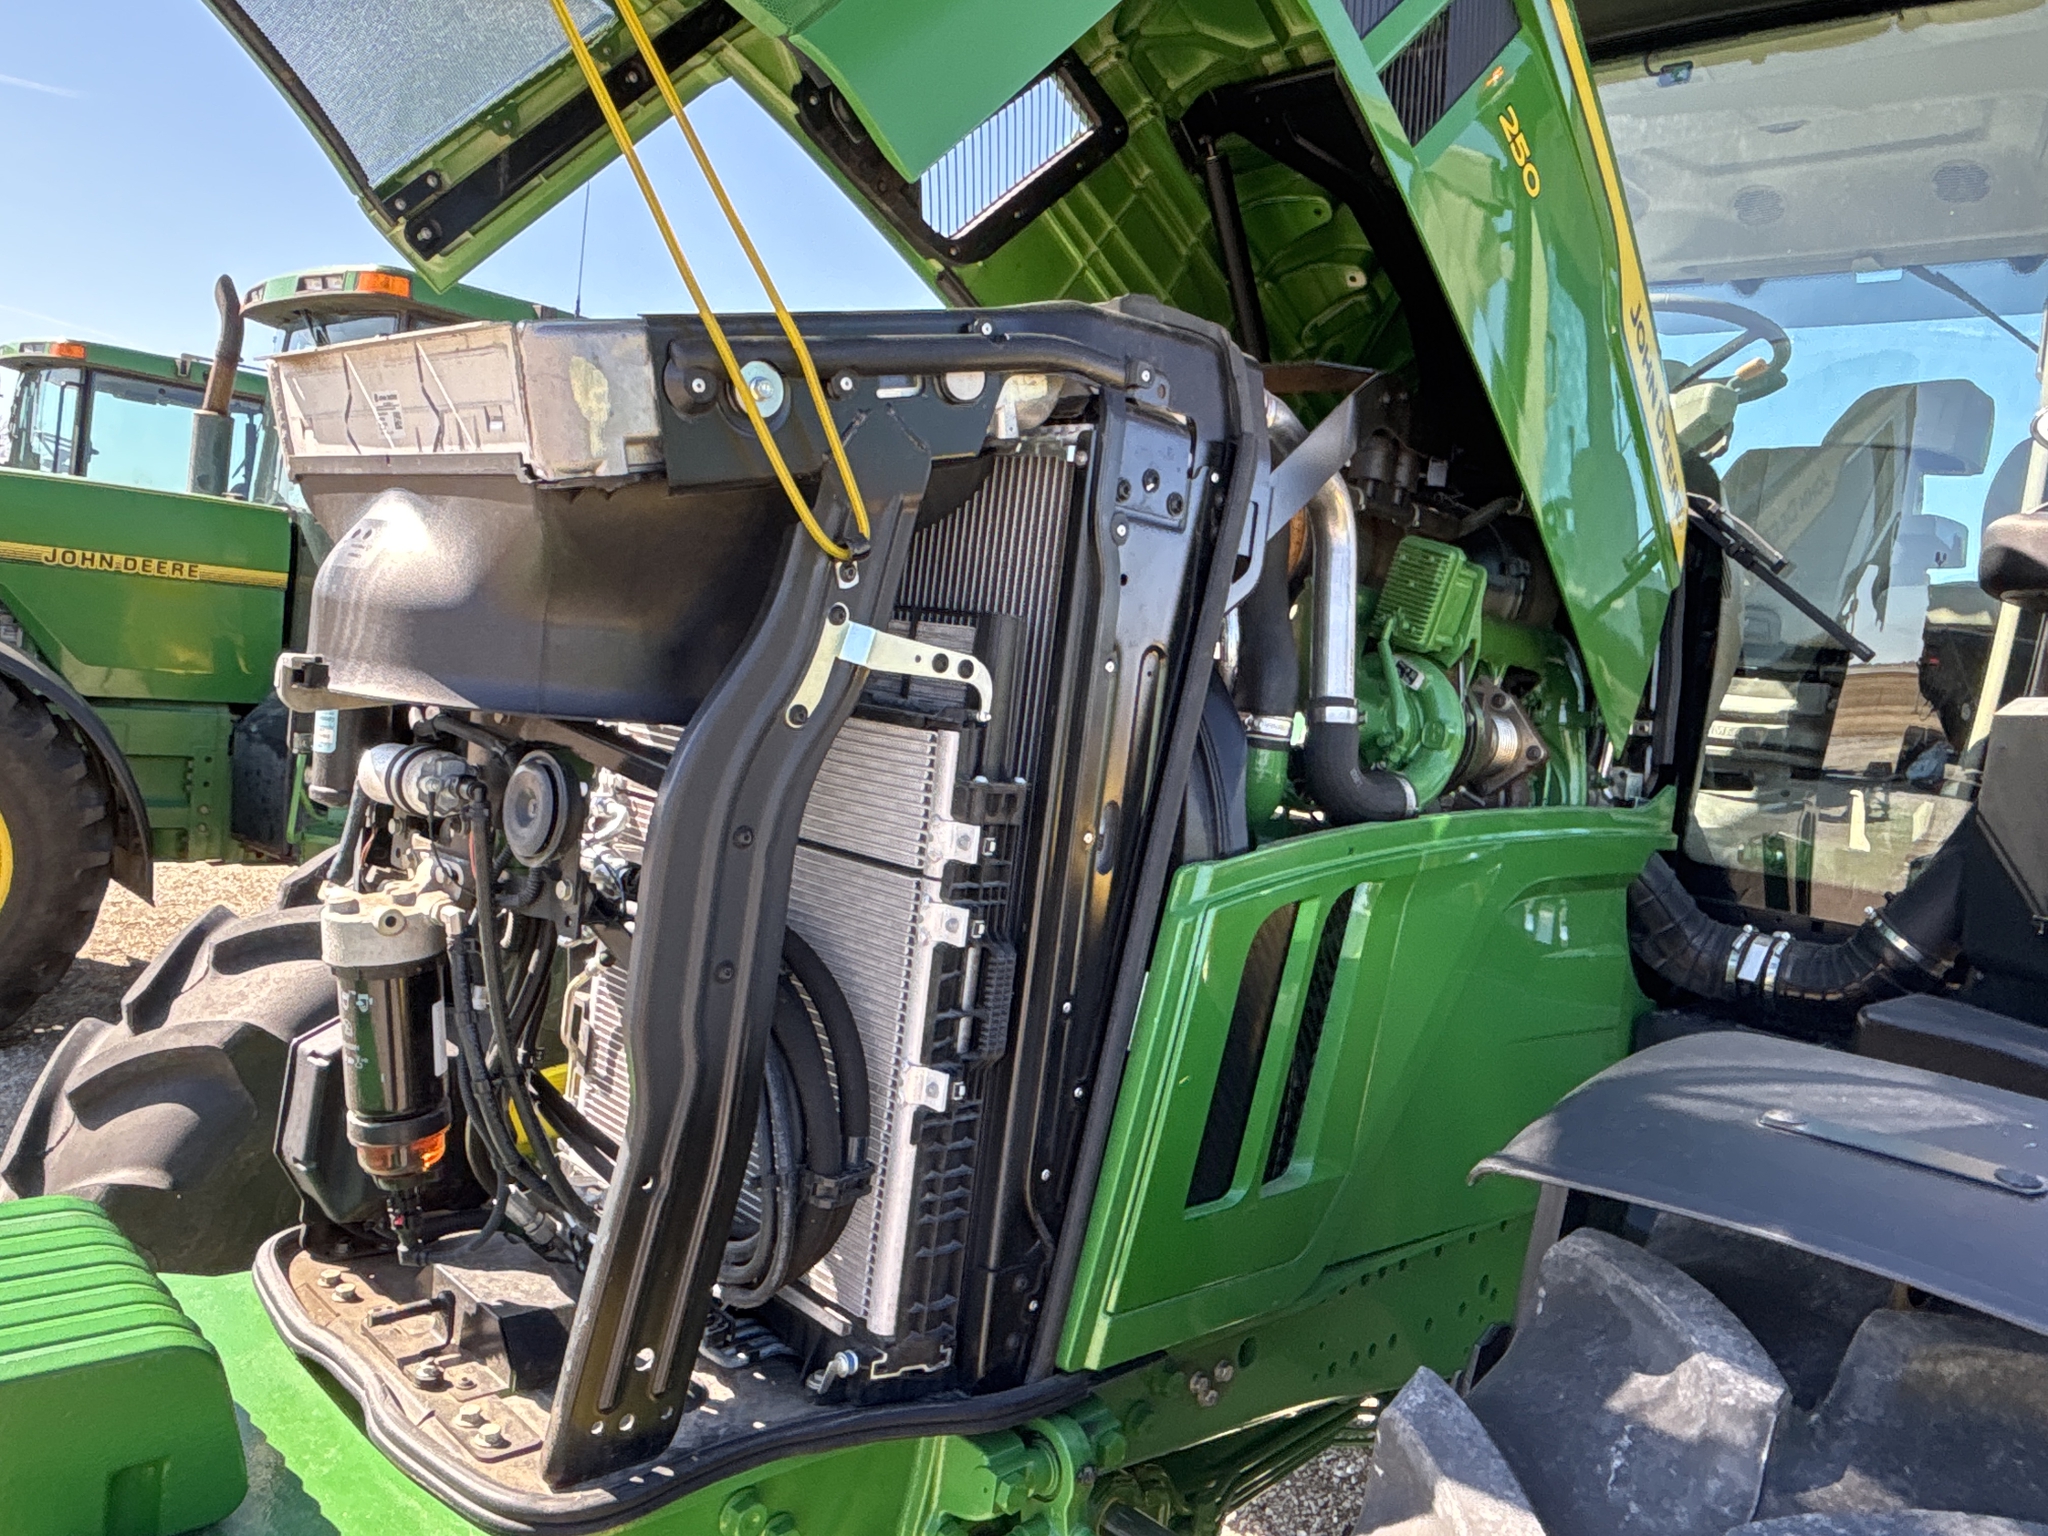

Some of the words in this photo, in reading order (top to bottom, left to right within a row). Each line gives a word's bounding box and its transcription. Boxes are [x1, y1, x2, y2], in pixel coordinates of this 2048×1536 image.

[1499, 104, 1540, 198] 250
[1630, 302, 1659, 409] JOHN
[44, 549, 114, 570] JOHN
[123, 557, 199, 578] DEERE
